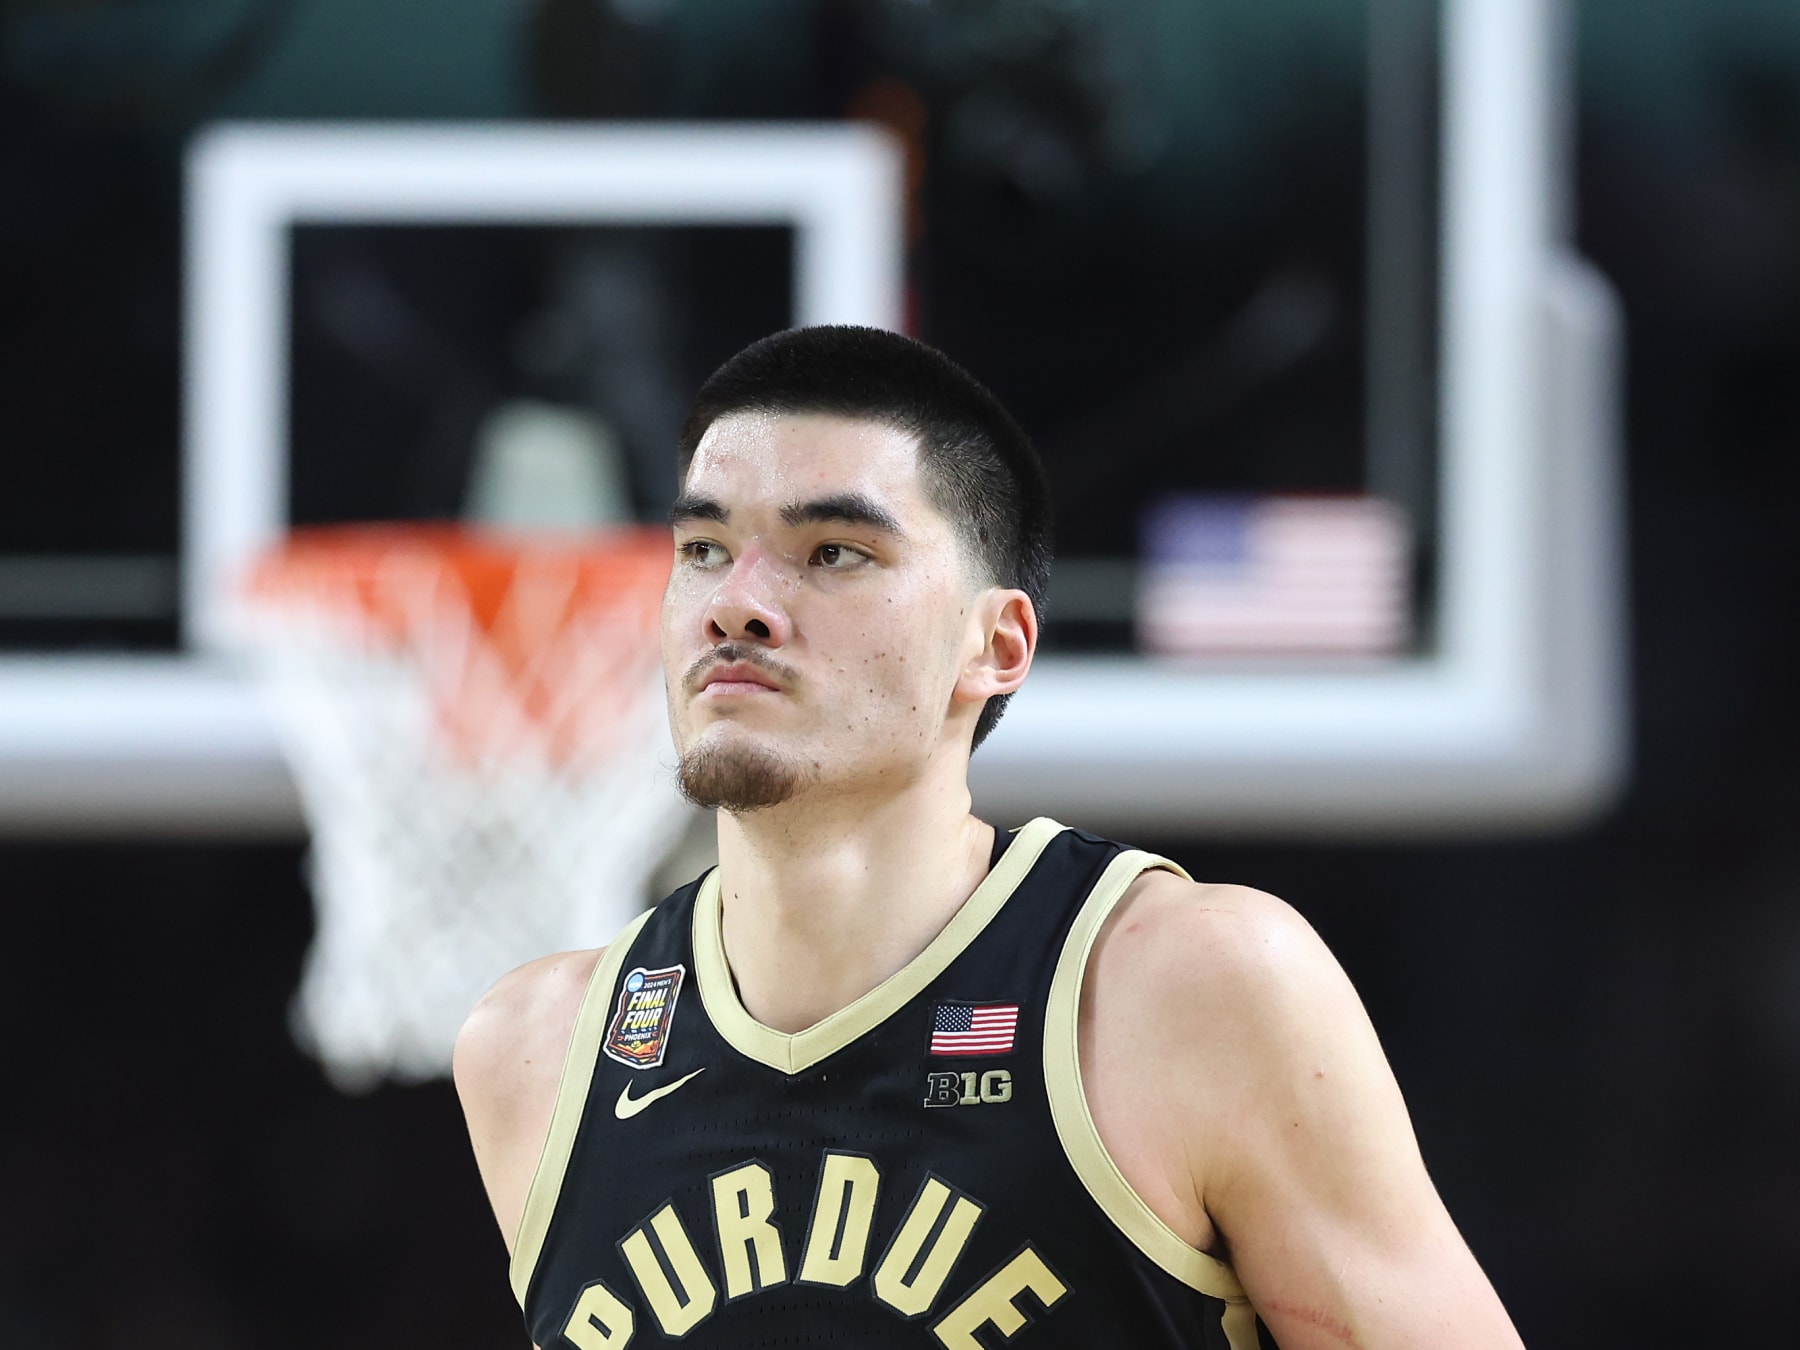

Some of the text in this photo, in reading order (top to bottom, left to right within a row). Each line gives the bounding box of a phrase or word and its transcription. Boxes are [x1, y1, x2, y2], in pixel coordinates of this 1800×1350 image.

[627, 988, 668, 1011] FINAL
[622, 1008, 664, 1030] FOUR
[624, 1032, 652, 1041] PHOENIX
